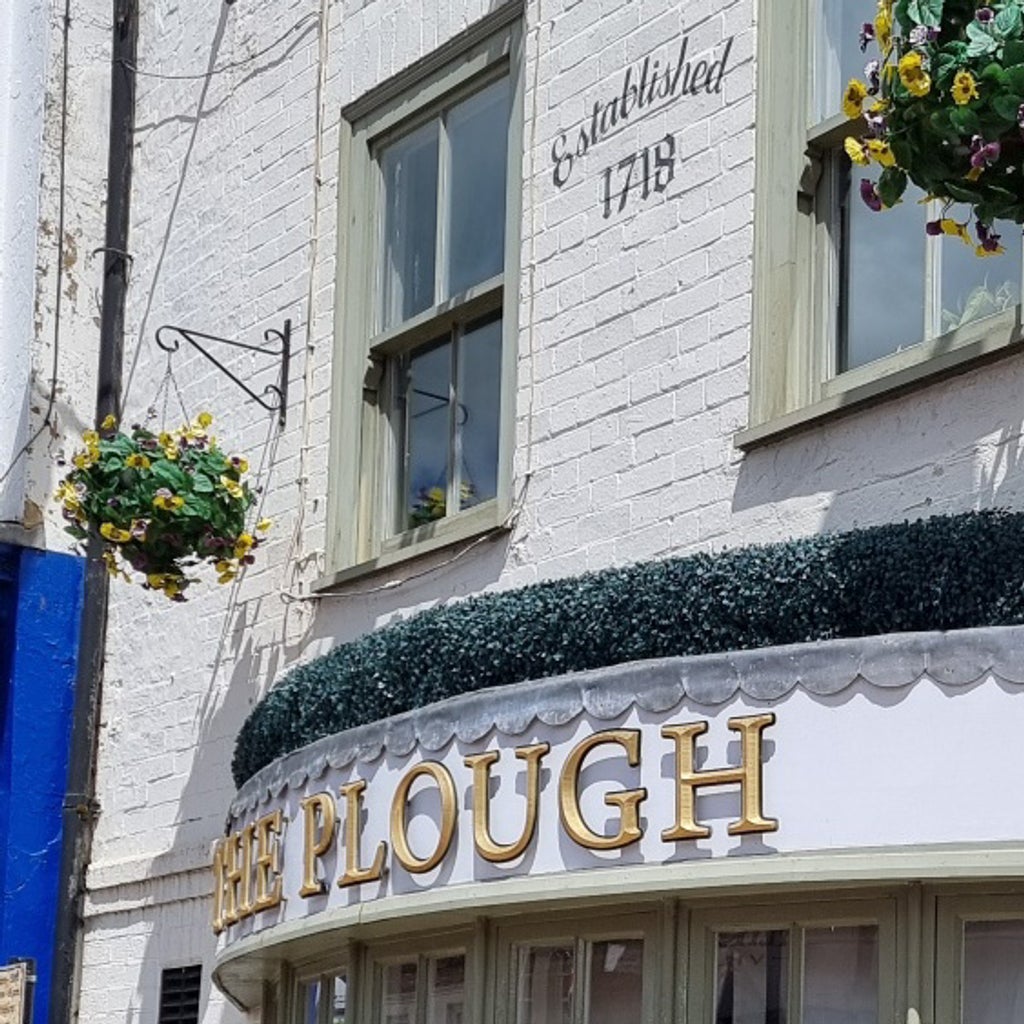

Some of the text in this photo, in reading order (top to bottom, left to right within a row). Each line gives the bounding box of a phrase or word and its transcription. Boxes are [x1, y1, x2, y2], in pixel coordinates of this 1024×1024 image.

[551, 37, 734, 188] Established
[602, 133, 675, 219] 1718
[212, 712, 778, 935] THE PLOUGH
